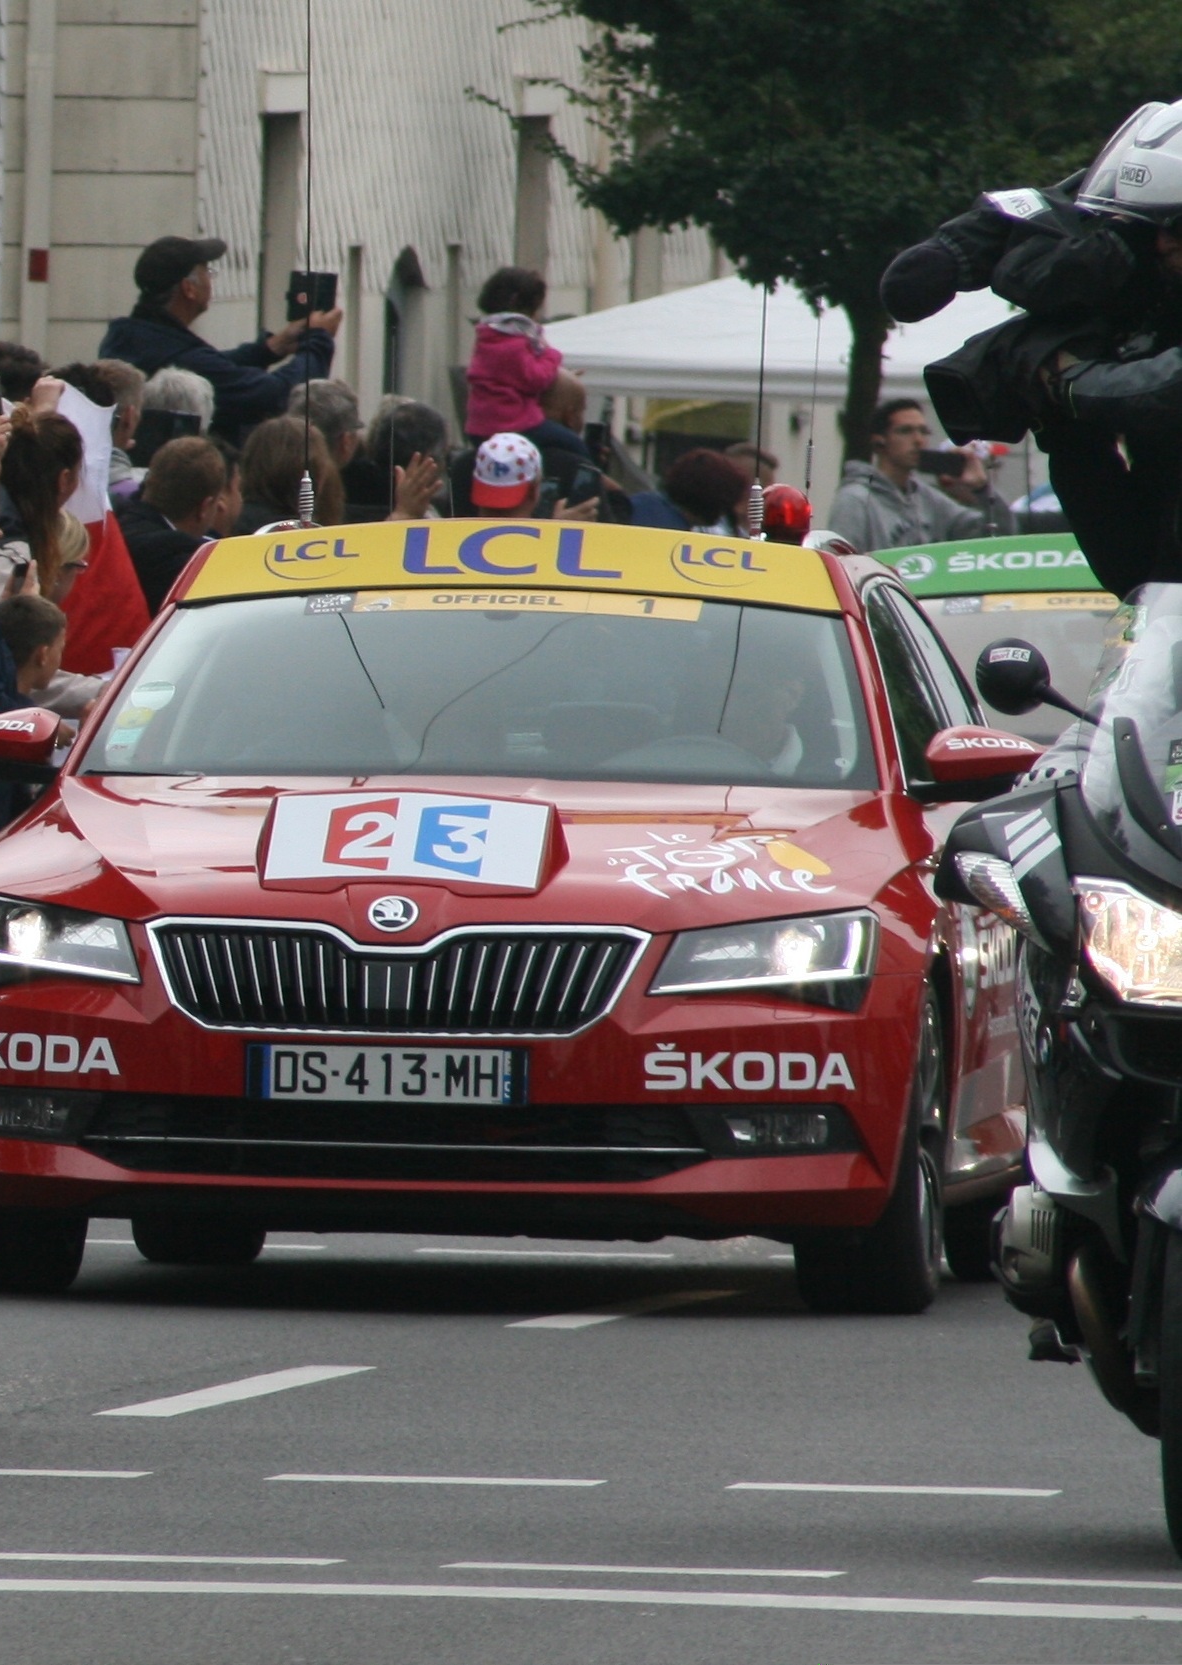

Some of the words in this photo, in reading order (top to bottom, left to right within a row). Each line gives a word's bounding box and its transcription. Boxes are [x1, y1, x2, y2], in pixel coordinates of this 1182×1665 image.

[274, 539, 359, 563] LCL
[402, 525, 622, 579] LCL
[680, 544, 767, 572] LCL
[431, 594, 564, 606] OFFICIEL
[637, 598, 655, 614] 1
[1047, 597, 1118, 605] OFFIC
[339, 811, 396, 860] 2
[432, 813, 490, 864] 3
[274, 1051, 499, 1098] DS-413-MH
[644, 1043, 856, 1091] ŠKODA
